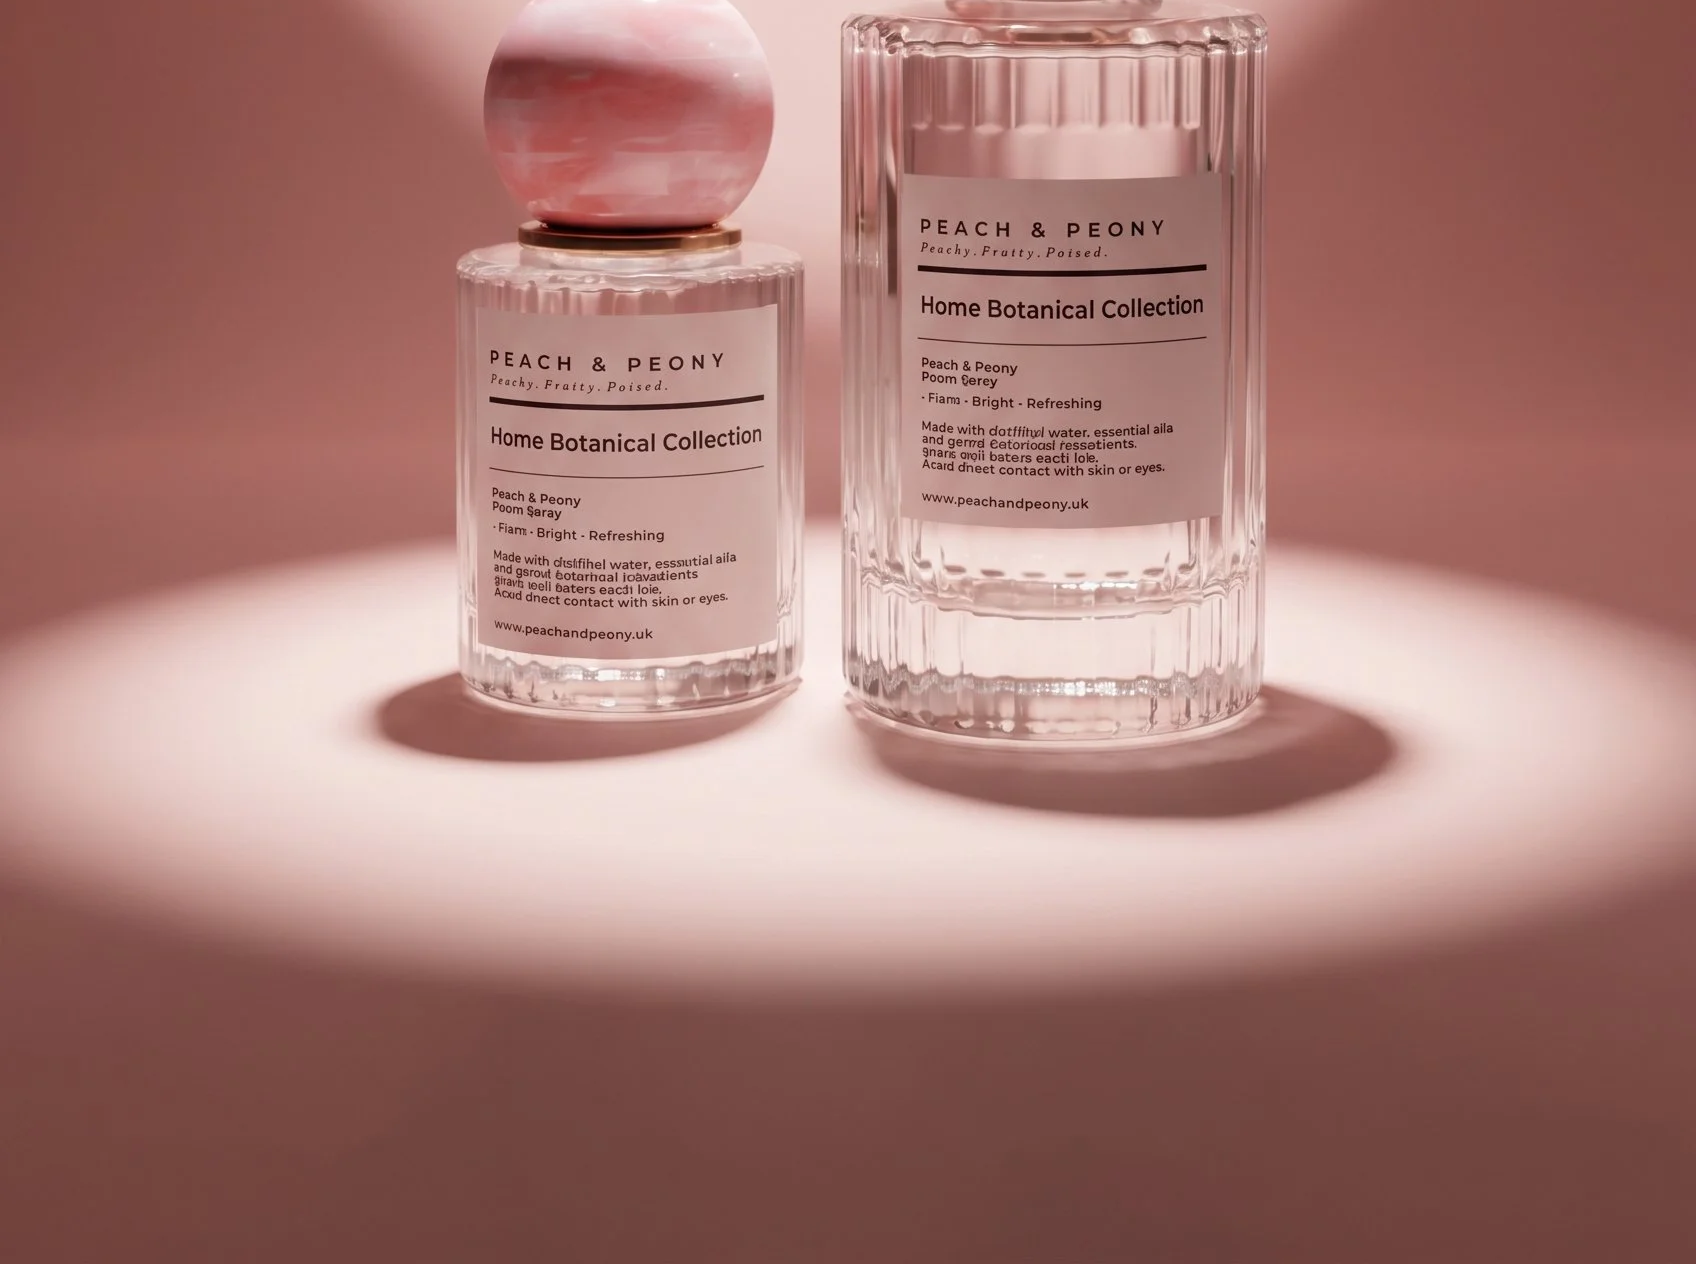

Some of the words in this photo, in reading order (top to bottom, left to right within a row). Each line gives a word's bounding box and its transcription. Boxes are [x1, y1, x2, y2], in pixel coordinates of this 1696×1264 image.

[921, 218, 1010, 237] PEACH
[1031, 222, 1046, 238] &
[1067, 220, 1164, 237] PEONY
[920, 242, 976, 258] Peachy.
[1046, 246, 1108, 258] Poised.
[921, 295, 981, 317] Home
[988, 299, 1094, 319] Botanical
[1102, 295, 1204, 319] Collection
[490, 350, 571, 371] PEACH
[592, 357, 606, 372] &
[628, 353, 724, 372] PEONY
[922, 357, 958, 371] Peach
[963, 360, 971, 371] &
[975, 361, 1018, 376] Peony
[490, 373, 539, 391] Peachy.
[607, 380, 668, 392] Poised.
[972, 396, 1014, 410] Bright
[1027, 397, 1102, 411] Refreshing
[922, 420, 954, 433] Made
[957, 424, 985, 436] with
[1094, 424, 1150, 438] essential
[491, 426, 544, 450] Home
[550, 433, 655, 453] Botanical
[663, 426, 762, 451] Collection
[922, 435, 944, 445] and
[990, 451, 1032, 463] baters
[999, 465, 1050, 476] contact
[1054, 465, 1084, 476] with
[1088, 464, 1115, 476] skin
[1119, 465, 1131, 475] or
[1135, 463, 1165, 475] eyes.
[492, 487, 525, 502] Peach
[528, 492, 537, 503] &
[540, 493, 581, 508] Peony
[922, 493, 1089, 512] www.peachandpeony.uk
[537, 527, 577, 542] Bright
[589, 530, 665, 543] Refreshing
[493, 549, 521, 563] Made
[525, 554, 549, 567] with
[610, 560, 651, 571] water,
[494, 564, 512, 574] and
[564, 597, 614, 608] contact
[618, 597, 647, 607] with
[652, 596, 679, 607] skin
[683, 596, 695, 605] or
[699, 593, 728, 605] eyes.
[494, 620, 653, 642] www.peachandpeony.uk
